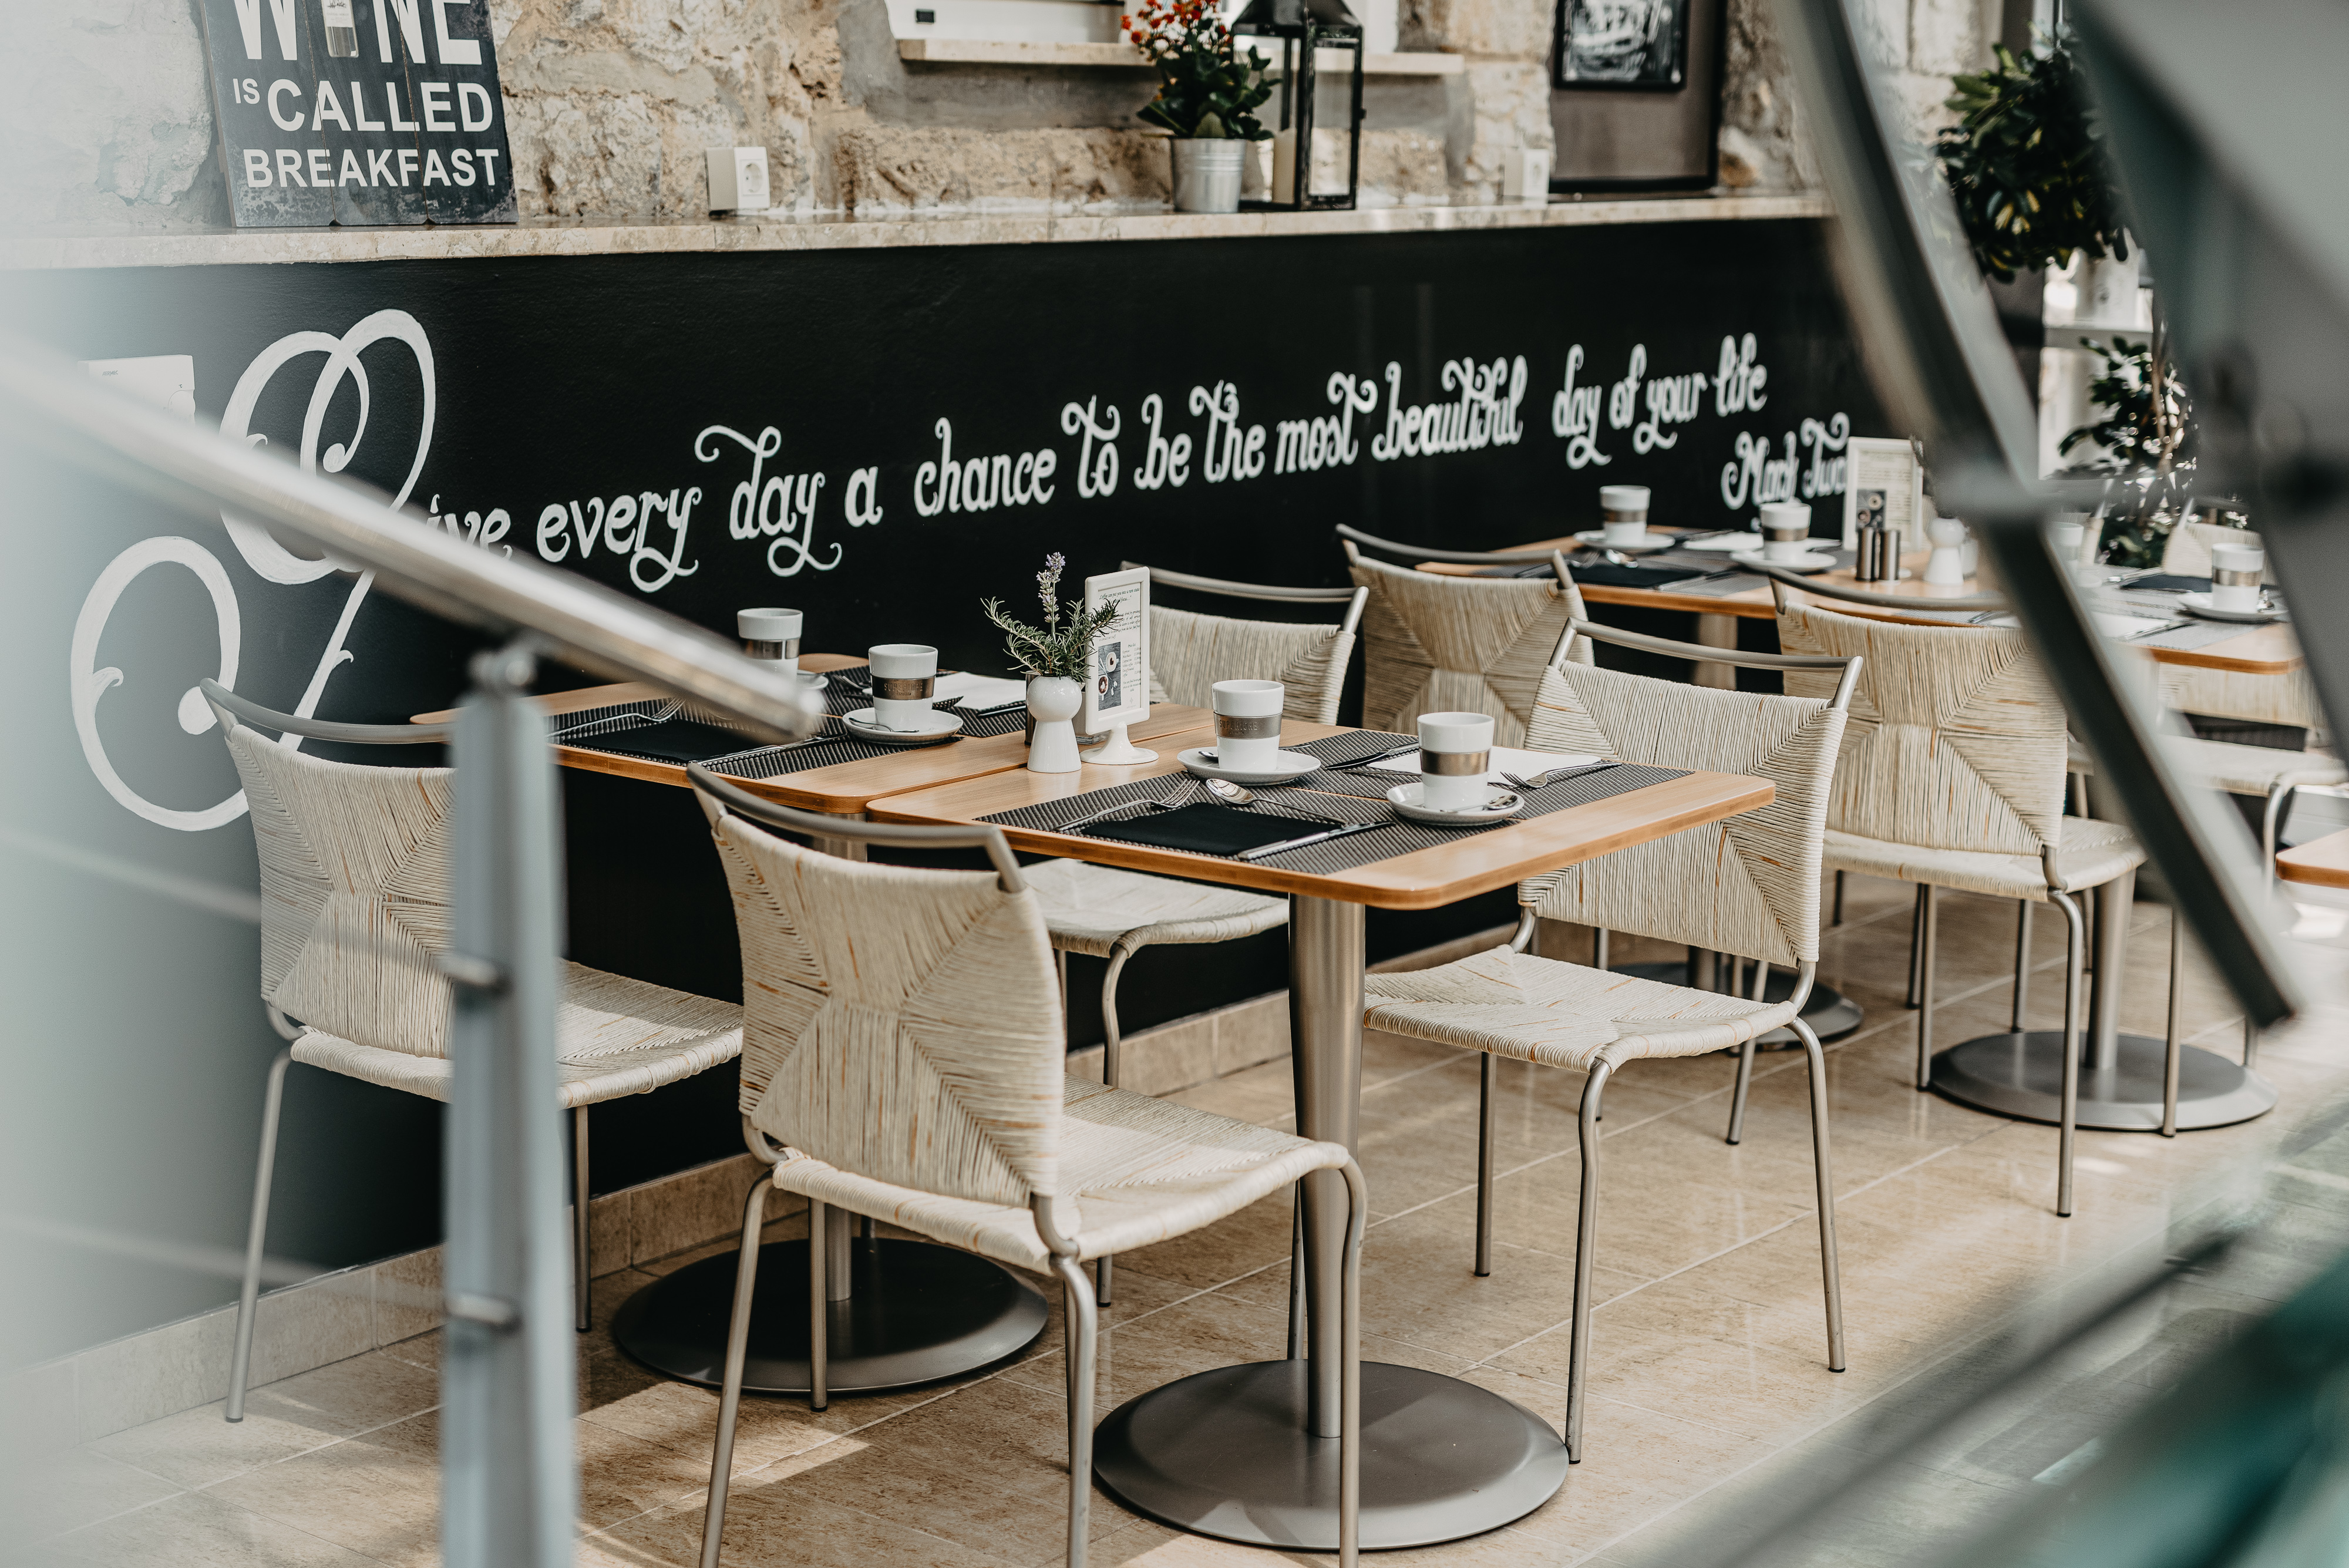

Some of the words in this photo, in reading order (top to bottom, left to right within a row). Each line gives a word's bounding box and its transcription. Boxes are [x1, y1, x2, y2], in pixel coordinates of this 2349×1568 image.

[233, 78, 260, 104] IS
[267, 79, 493, 132] CALLED
[243, 149, 499, 187] BREAKFAST
[537, 487, 702, 593] every
[695, 425, 842, 577] day
[845, 466, 883, 527] a
[914, 418, 1056, 517] chance
[1061, 395, 1120, 498] to
[1134, 393, 1192, 490] be
[1189, 380, 1266, 483] the
[1274, 372, 1378, 475] most
[1372, 354, 1528, 461] beautiful
[1553, 344, 1611, 469] day
[1609, 344, 1647, 429] of
[1633, 372, 1708, 454] your
[1712, 332, 1768, 416] life
[1721, 431, 1799, 510] Mark
[1801, 412, 1849, 499] Twa
